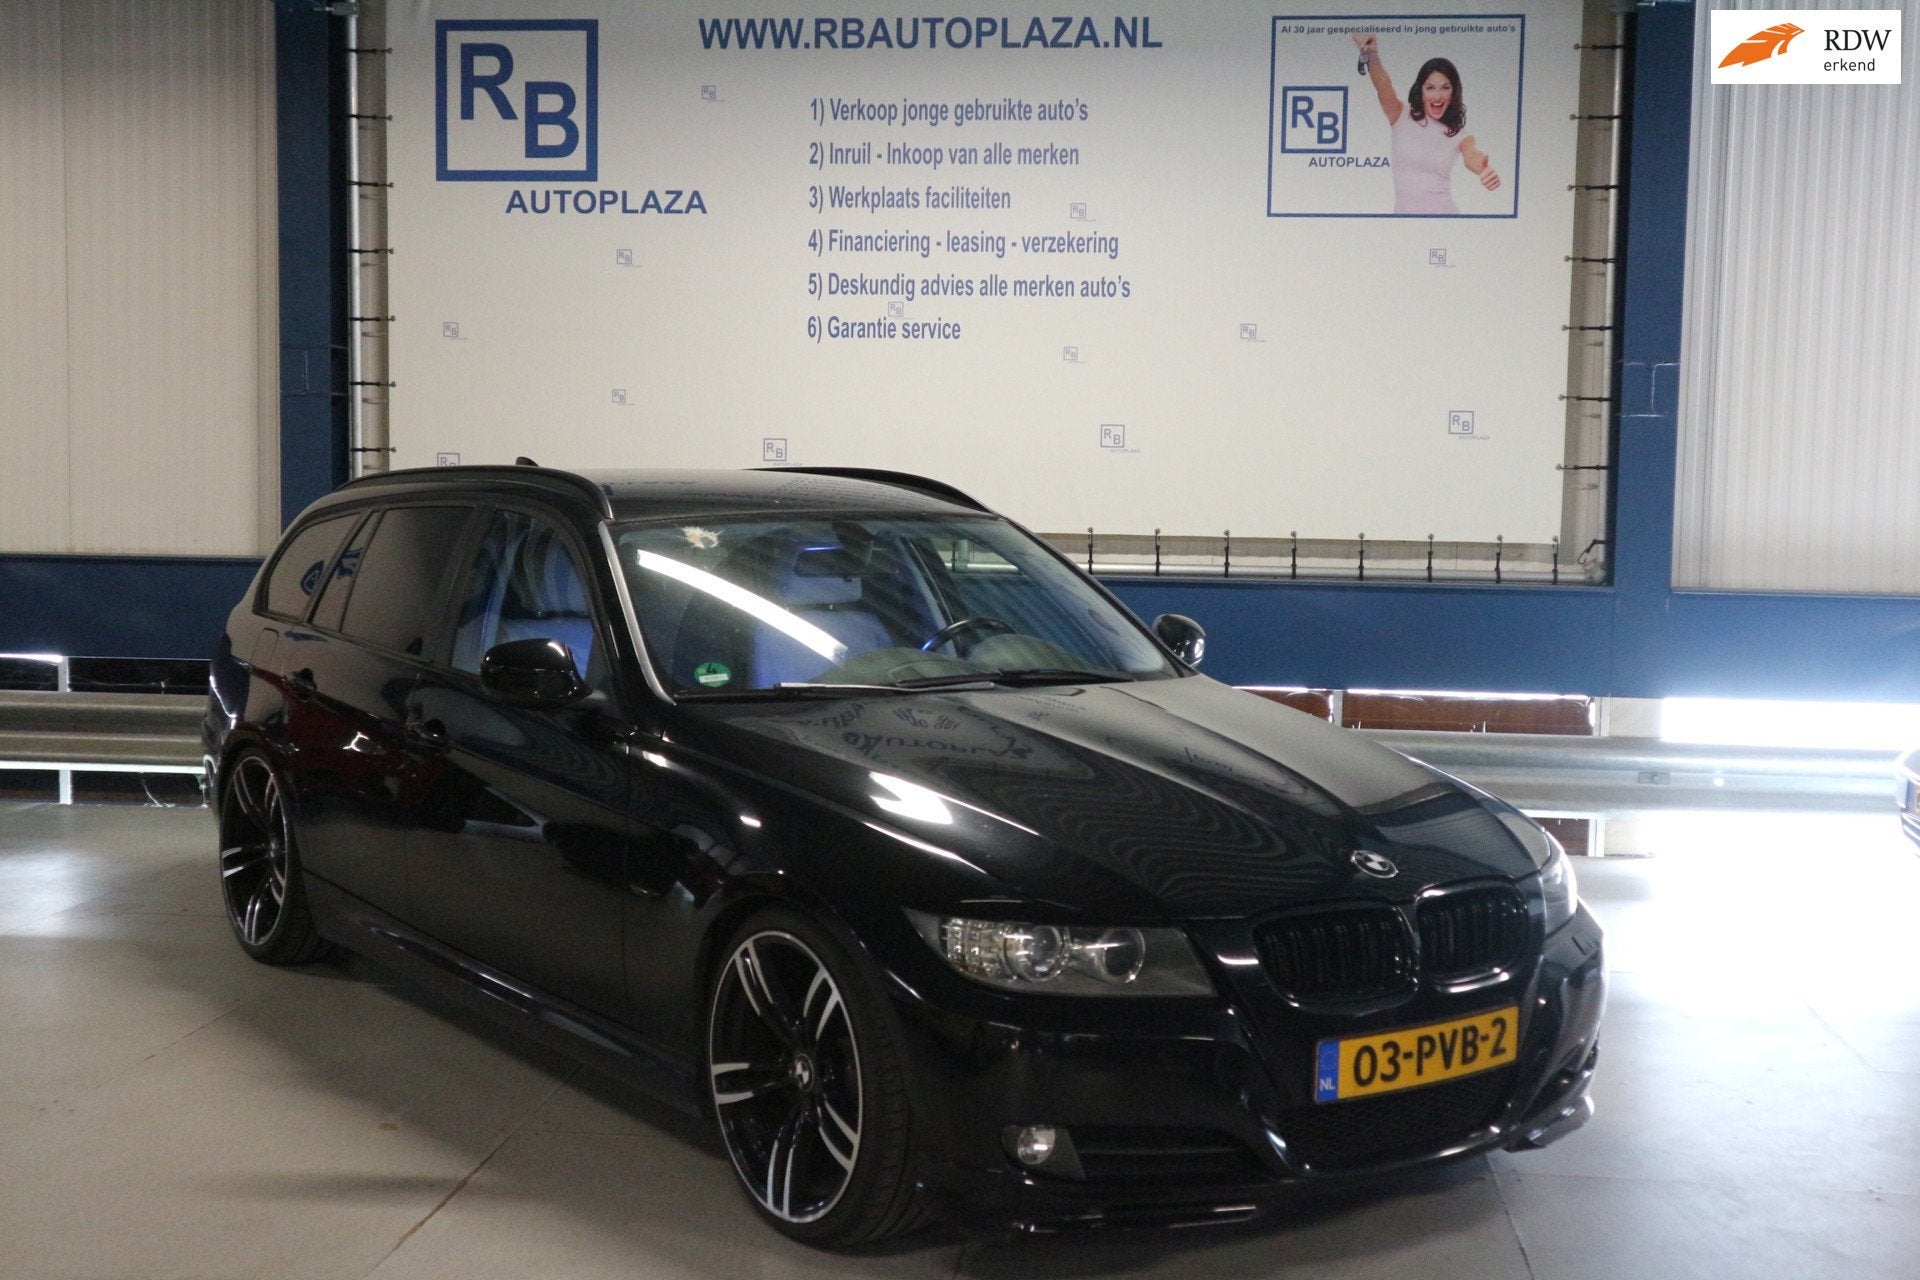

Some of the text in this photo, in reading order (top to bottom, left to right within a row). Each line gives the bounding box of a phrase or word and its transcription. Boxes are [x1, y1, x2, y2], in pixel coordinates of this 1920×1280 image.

[698, 16, 1163, 50] WWW.RBAUTOPLAZA.NL
[1294, 25, 1305, 33] 30
[1307, 25, 1325, 35] jaar
[1327, 25, 1401, 35] gespecialiseerd
[1404, 25, 1413, 33] in
[1415, 25, 1437, 34] jong
[1439, 24, 1484, 34] gebruikte
[810, 98, 1089, 127] 1) Verkoop jonge gebruikte auto's
[809, 142, 824, 170] 2)
[829, 142, 871, 164] Inruil
[887, 142, 944, 170] Inkoop
[949, 148, 978, 165] van
[983, 142, 1012, 165] alle
[1018, 142, 1080, 165] merken
[1308, 157, 1390, 168] AUTOPLAZA
[505, 190, 708, 215] AUTOPLAZA
[808, 186, 1011, 213] 3) Werkplaats faciliteiten
[808, 229, 823, 257] 4)
[829, 229, 931, 258] Financiering
[946, 230, 1006, 259] leasing
[1022, 230, 1120, 259] verzekering
[808, 273, 1131, 301] 5) Deskundig advies alle merken auto's
[807, 315, 961, 343] 6) Garantie service
[1353, 1017, 1507, 1087] 03-PVB-2
[1319, 1077, 1335, 1091] NL
